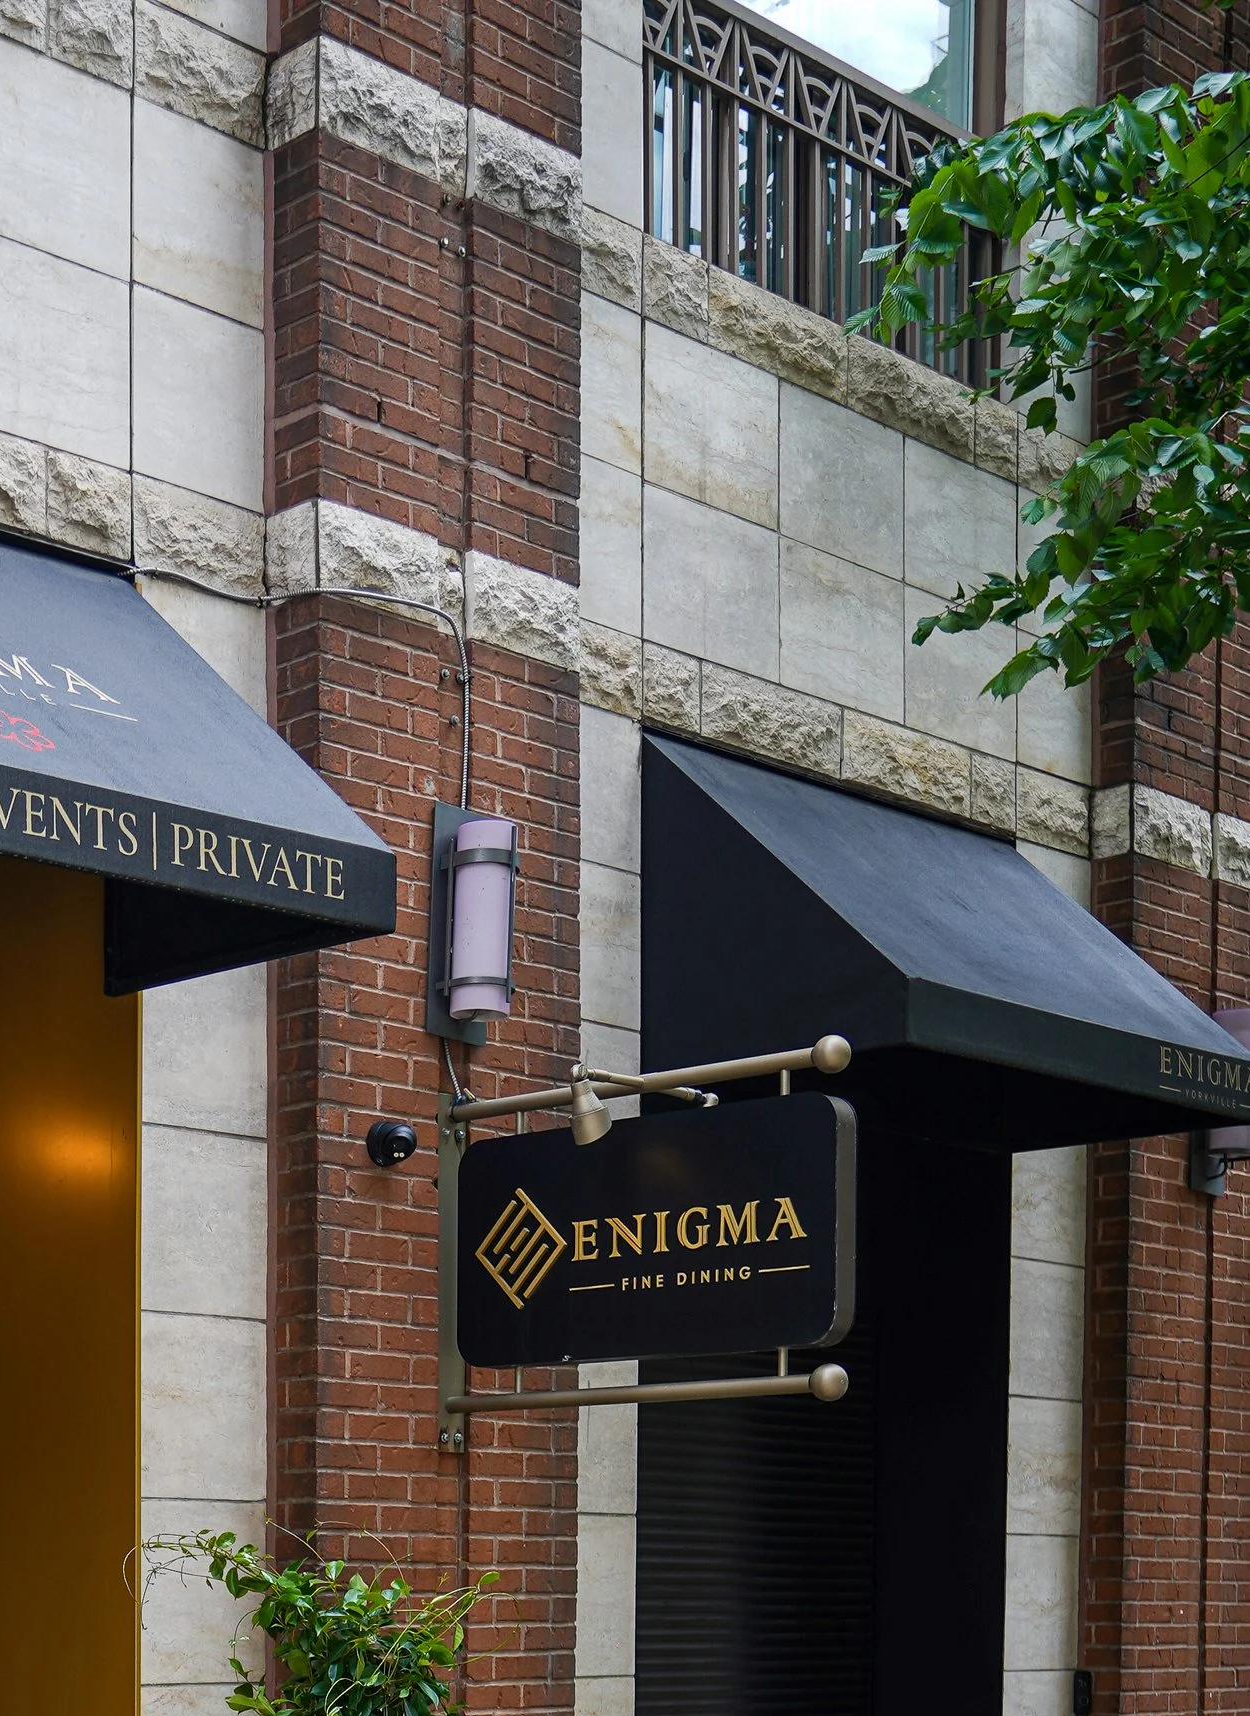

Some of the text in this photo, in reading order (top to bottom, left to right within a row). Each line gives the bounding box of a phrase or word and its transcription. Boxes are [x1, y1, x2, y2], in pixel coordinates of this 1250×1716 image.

[170, 822, 346, 901] PRIVATE
[1185, 1089, 1237, 1109] YORKVILLE
[570, 1196, 808, 1262] ENIGMA
[621, 1265, 752, 1291] FINE DINING
